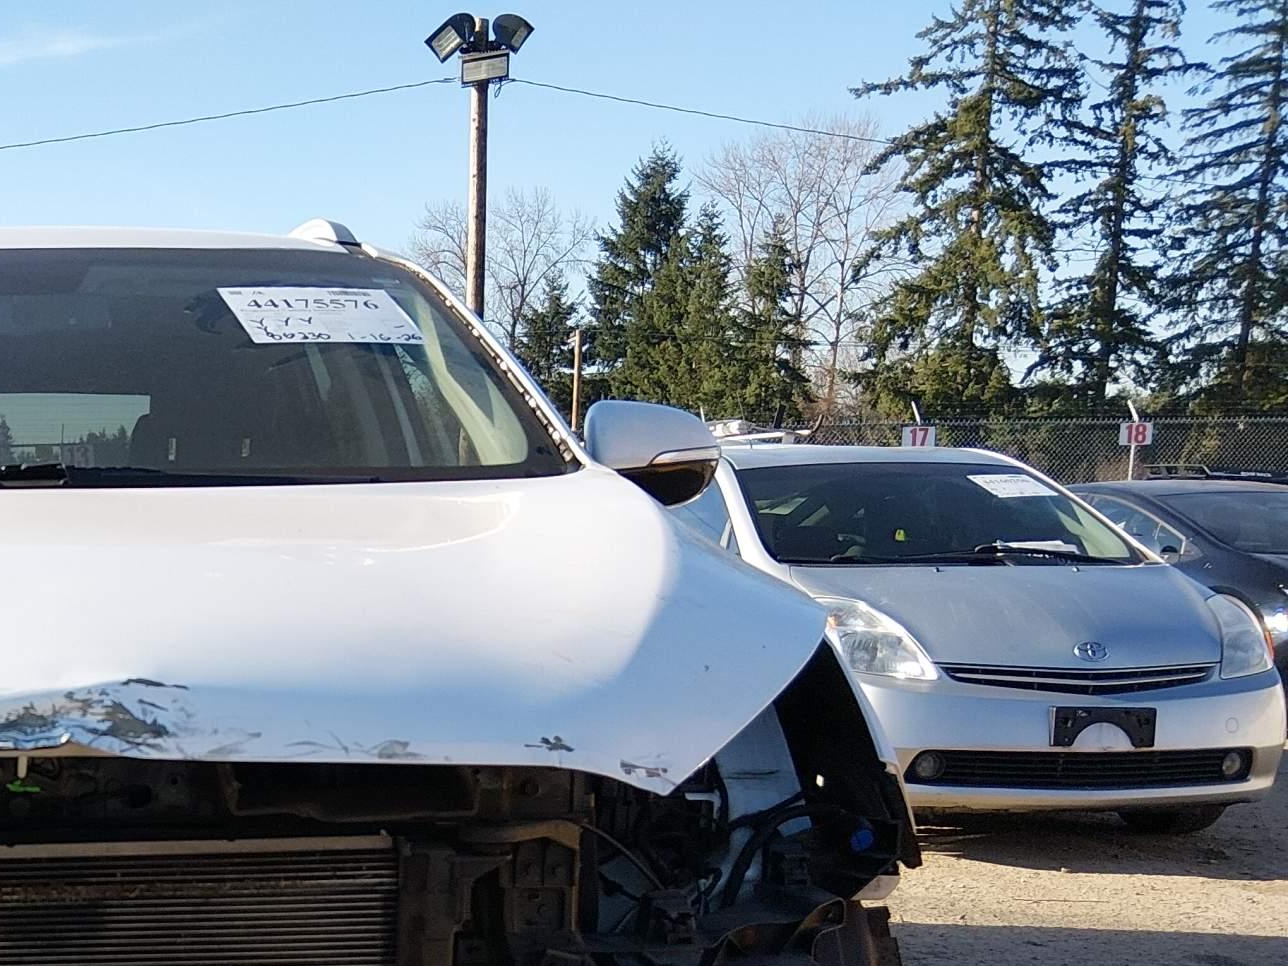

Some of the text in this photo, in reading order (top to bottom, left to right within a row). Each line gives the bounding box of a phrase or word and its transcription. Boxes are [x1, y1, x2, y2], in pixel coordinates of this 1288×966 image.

[247, 298, 379, 310] 44175576
[910, 427, 929, 447] 17
[1126, 423, 1147, 444] 18
